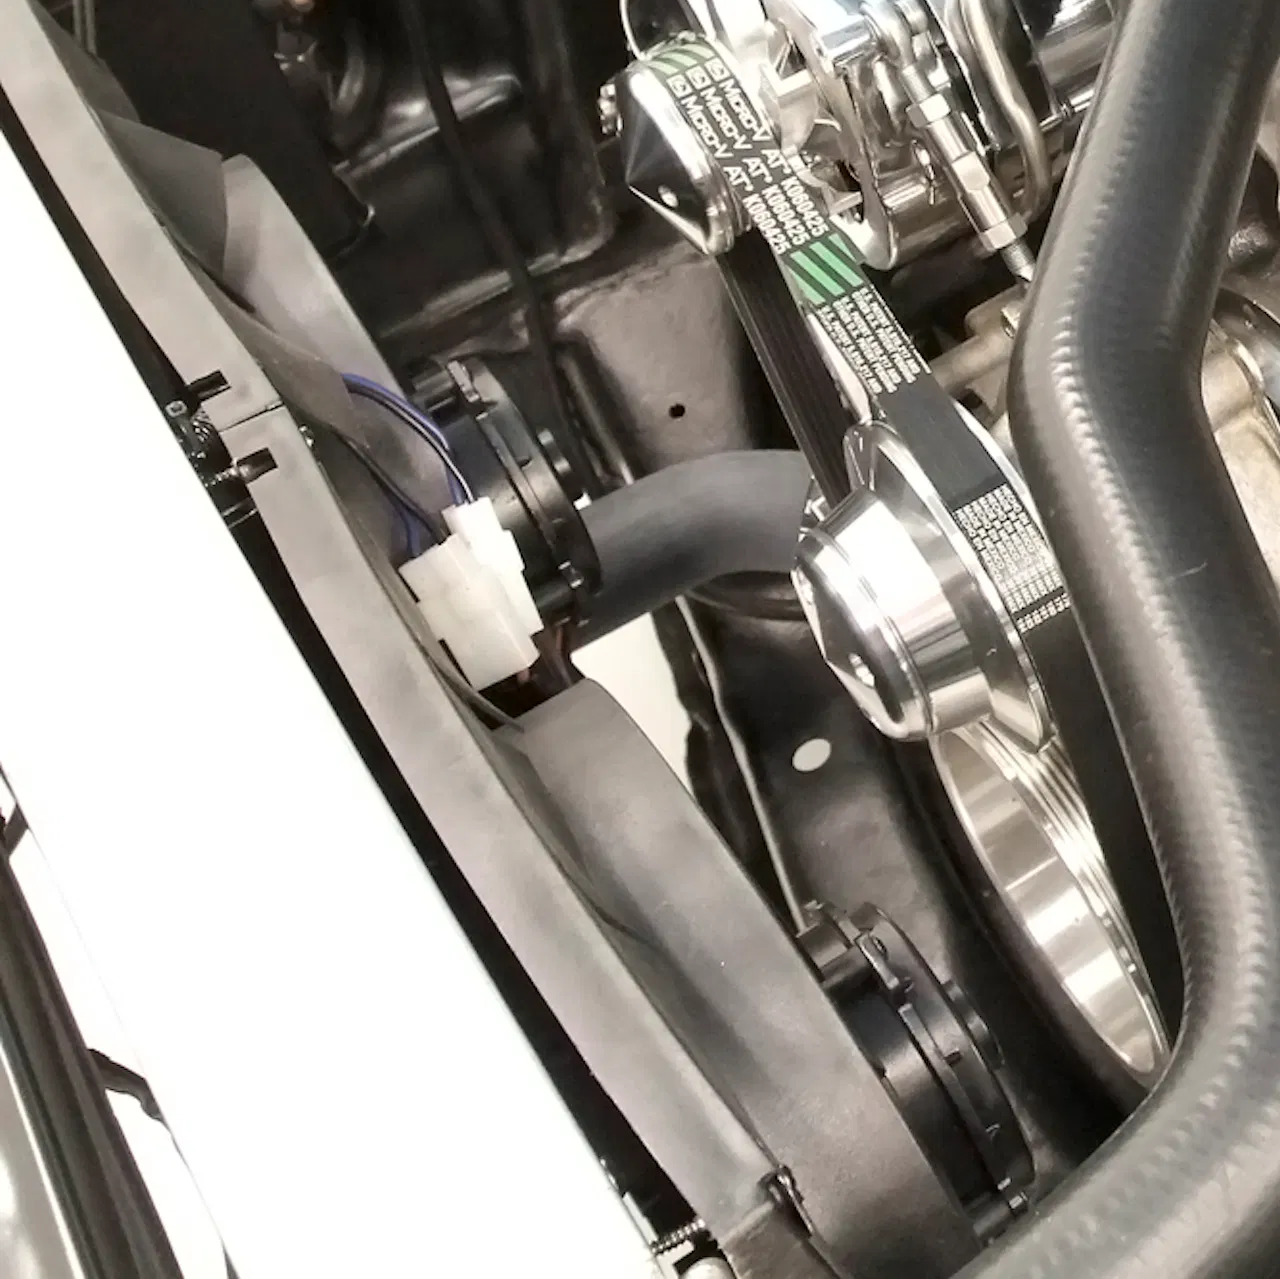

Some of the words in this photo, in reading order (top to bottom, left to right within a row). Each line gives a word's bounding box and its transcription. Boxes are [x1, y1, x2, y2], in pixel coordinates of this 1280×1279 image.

[742, 193, 792, 255] K060425
[762, 185, 810, 246] K060425
[781, 176, 829, 237] K060425
